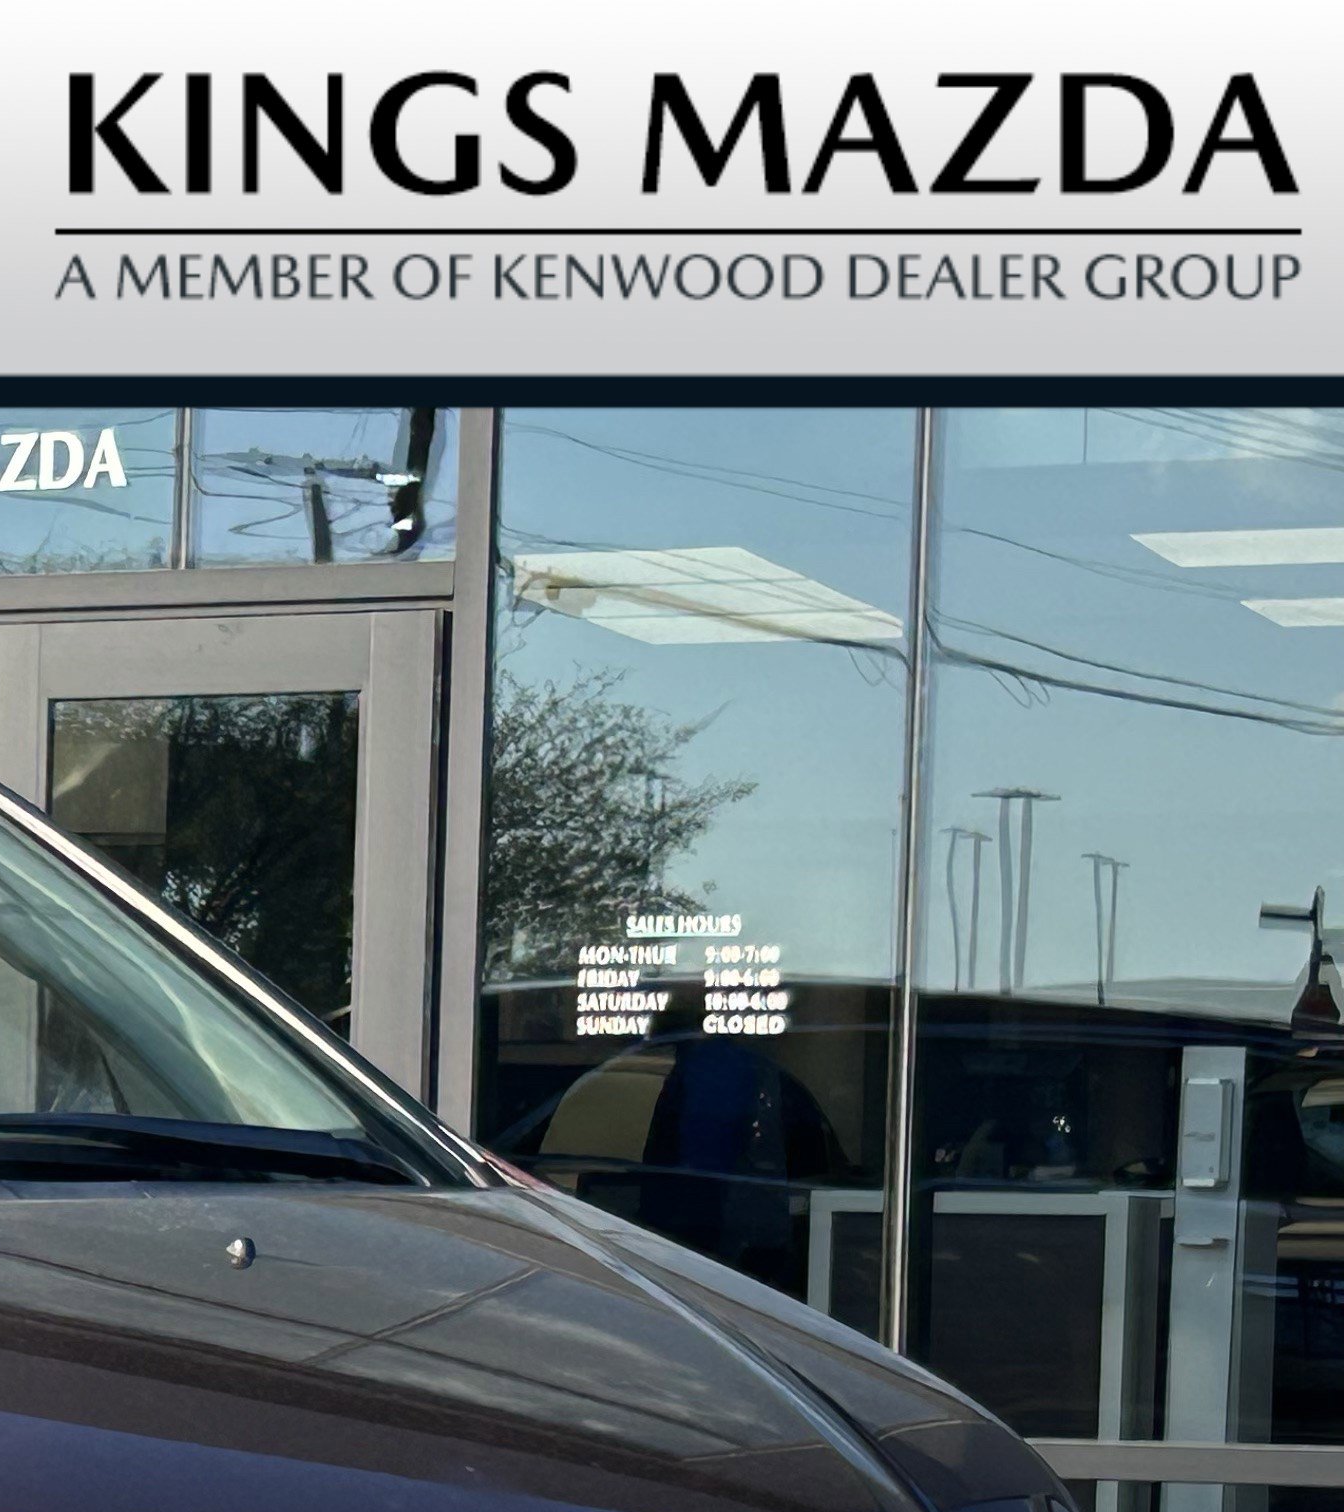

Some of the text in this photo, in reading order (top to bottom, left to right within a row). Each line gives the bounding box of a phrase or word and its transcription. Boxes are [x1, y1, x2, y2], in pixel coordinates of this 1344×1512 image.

[678, 914, 742, 935] HOURS
[577, 968, 641, 988] FRIDAY
[576, 991, 670, 1012] SATURDAY
[576, 1013, 787, 1036] SUNDAY CLOSED
